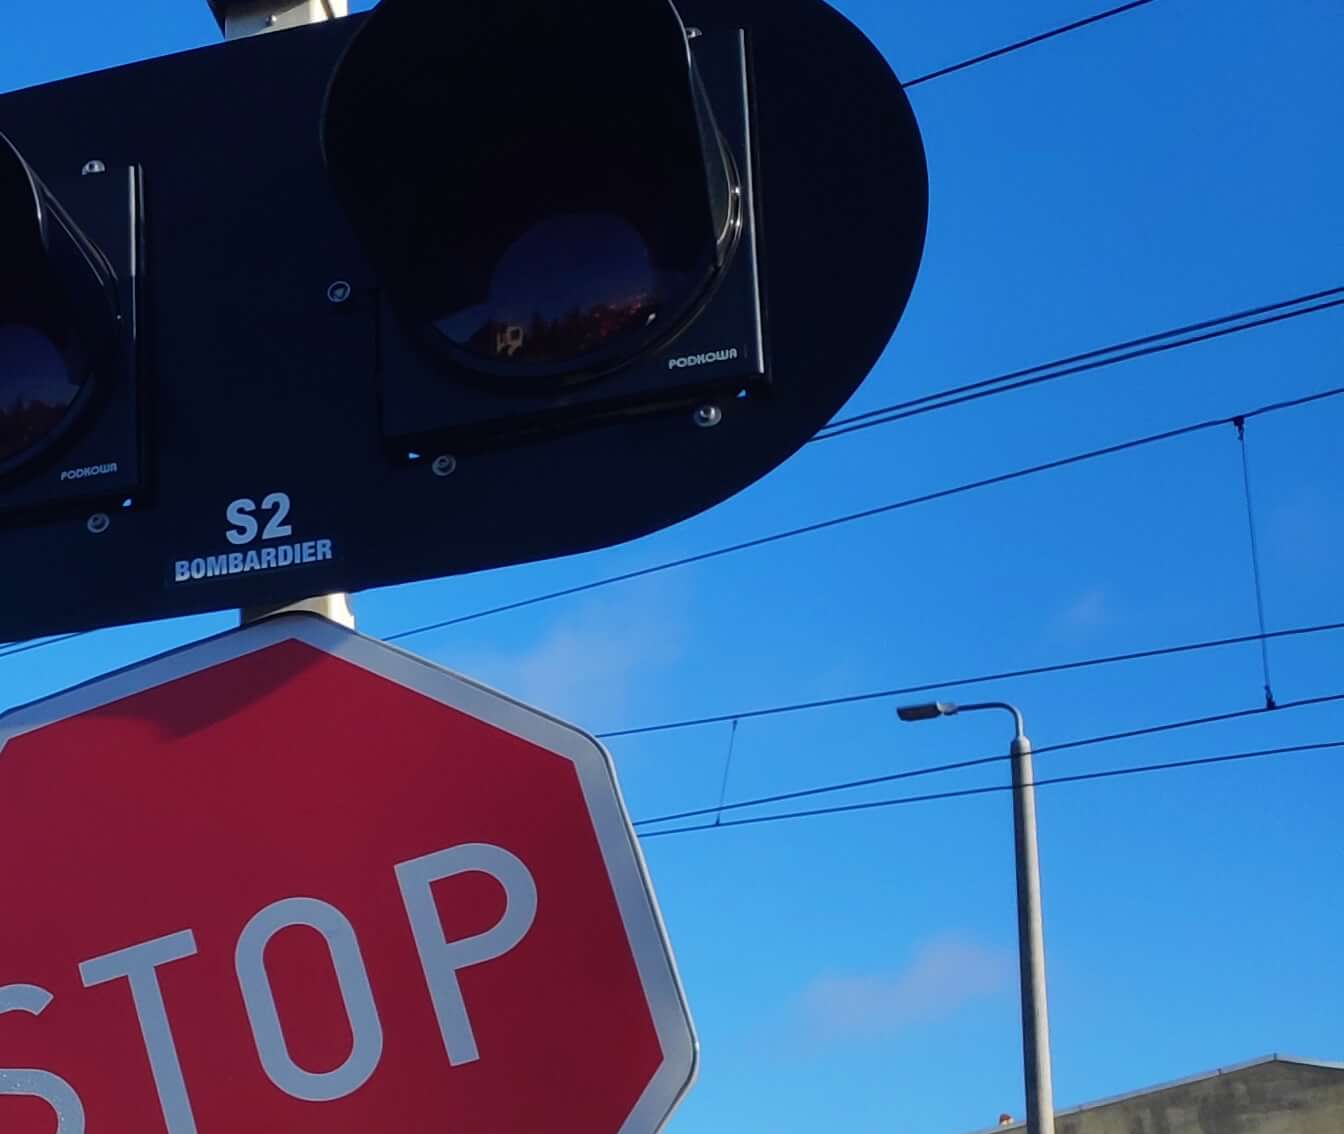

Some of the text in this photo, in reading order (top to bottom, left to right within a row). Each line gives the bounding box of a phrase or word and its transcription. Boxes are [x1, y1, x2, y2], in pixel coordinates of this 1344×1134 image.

[668, 348, 738, 370] PODKOWA
[60, 462, 118, 481] PODKOWA
[225, 492, 292, 545] S2
[175, 539, 332, 582] BOMBARDIER
